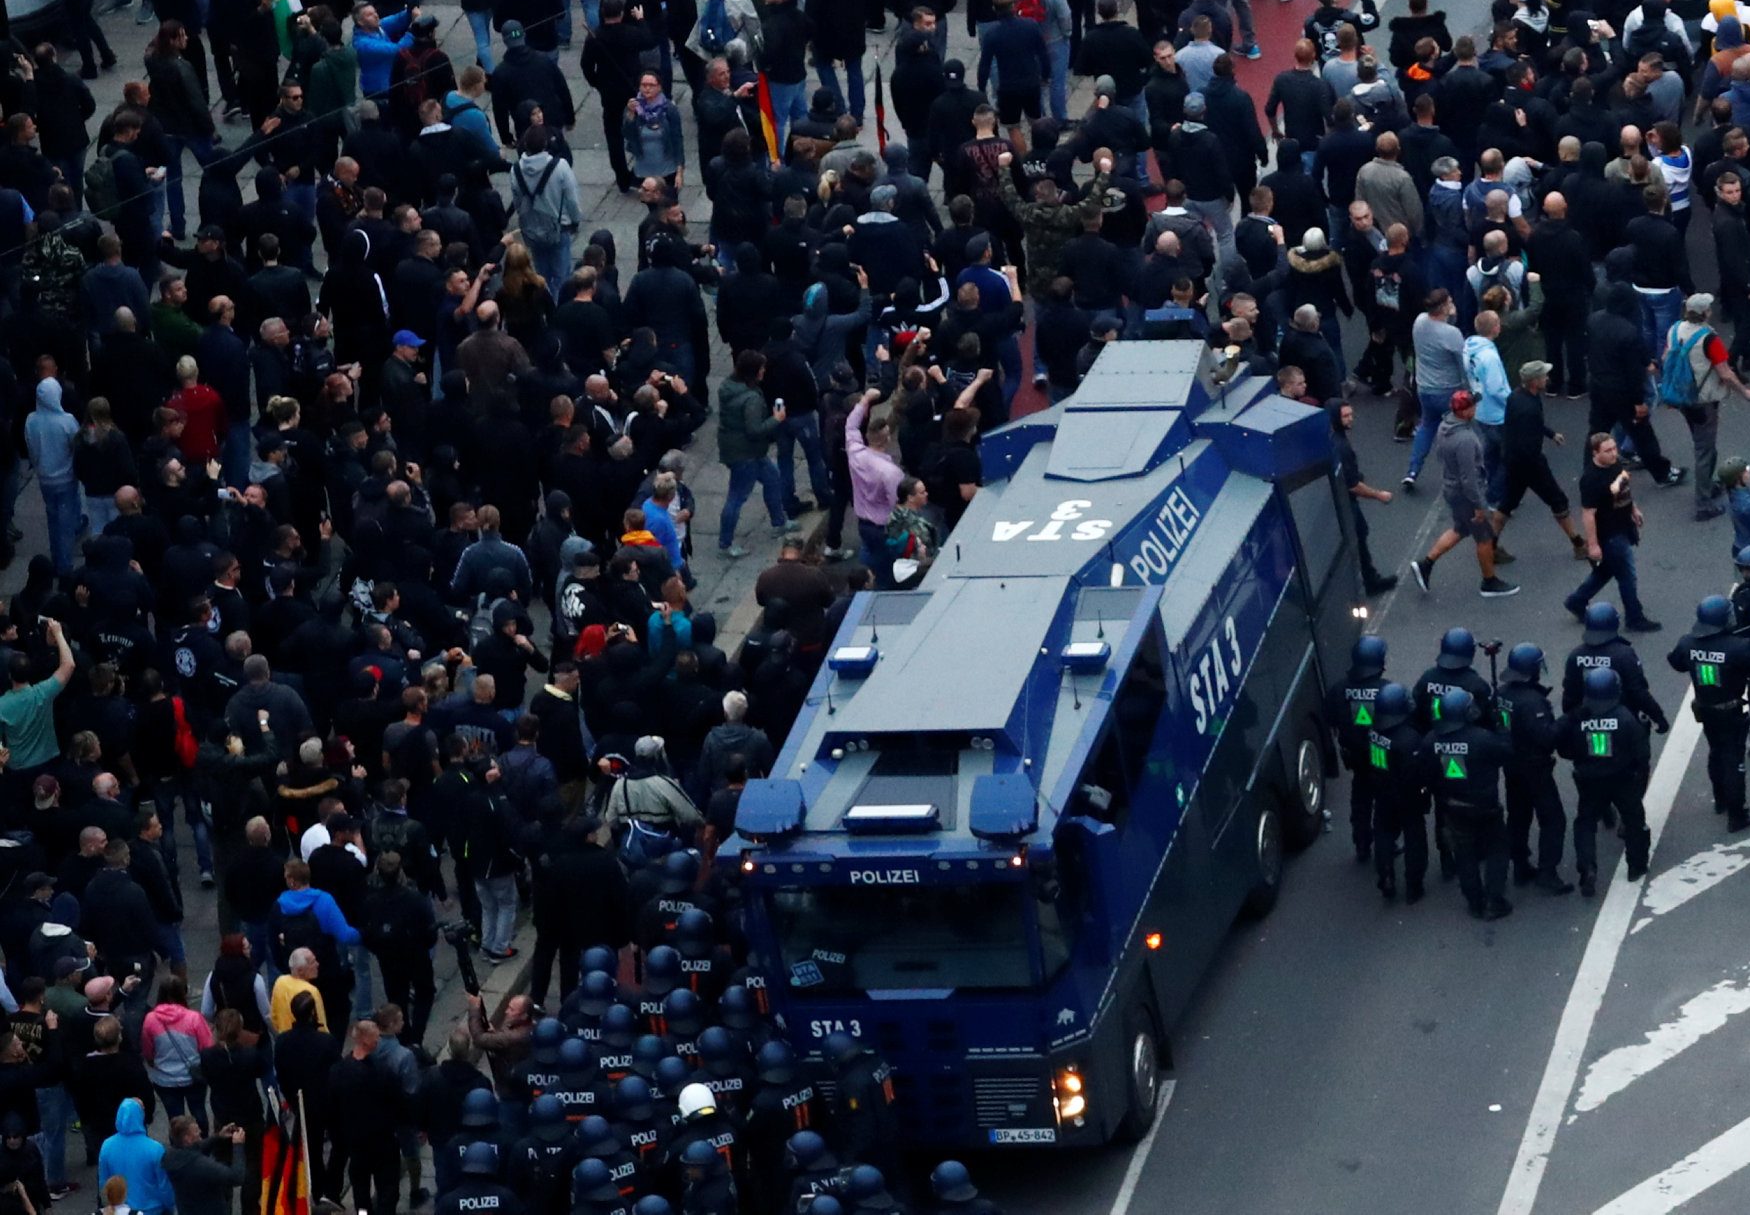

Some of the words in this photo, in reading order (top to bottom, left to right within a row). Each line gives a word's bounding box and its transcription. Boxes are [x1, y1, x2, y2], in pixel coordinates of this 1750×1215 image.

[992, 519, 1113, 542] STA
[1130, 486, 1200, 586] POLIZEI
[1576, 655, 1611, 668] POLIZEI
[1690, 649, 1726, 664] POLIZEI
[1190, 639, 1230, 735] STA
[1225, 616, 1242, 676] 3
[1345, 688, 1380, 701] POLIZE
[1581, 717, 1619, 732] POLIZEI
[1434, 742, 1469, 756] POLIZEI
[850, 869, 920, 885] POLIZEI
[812, 948, 846, 964] POLIZEI
[681, 959, 712, 972] OLIZEI
[811, 1020, 846, 1038] STA
[850, 1019, 862, 1037] 3
[781, 1086, 814, 1111] POLIZEI
[997, 1130, 1010, 1141] BP
[459, 1194, 500, 1211] POLIZEI
